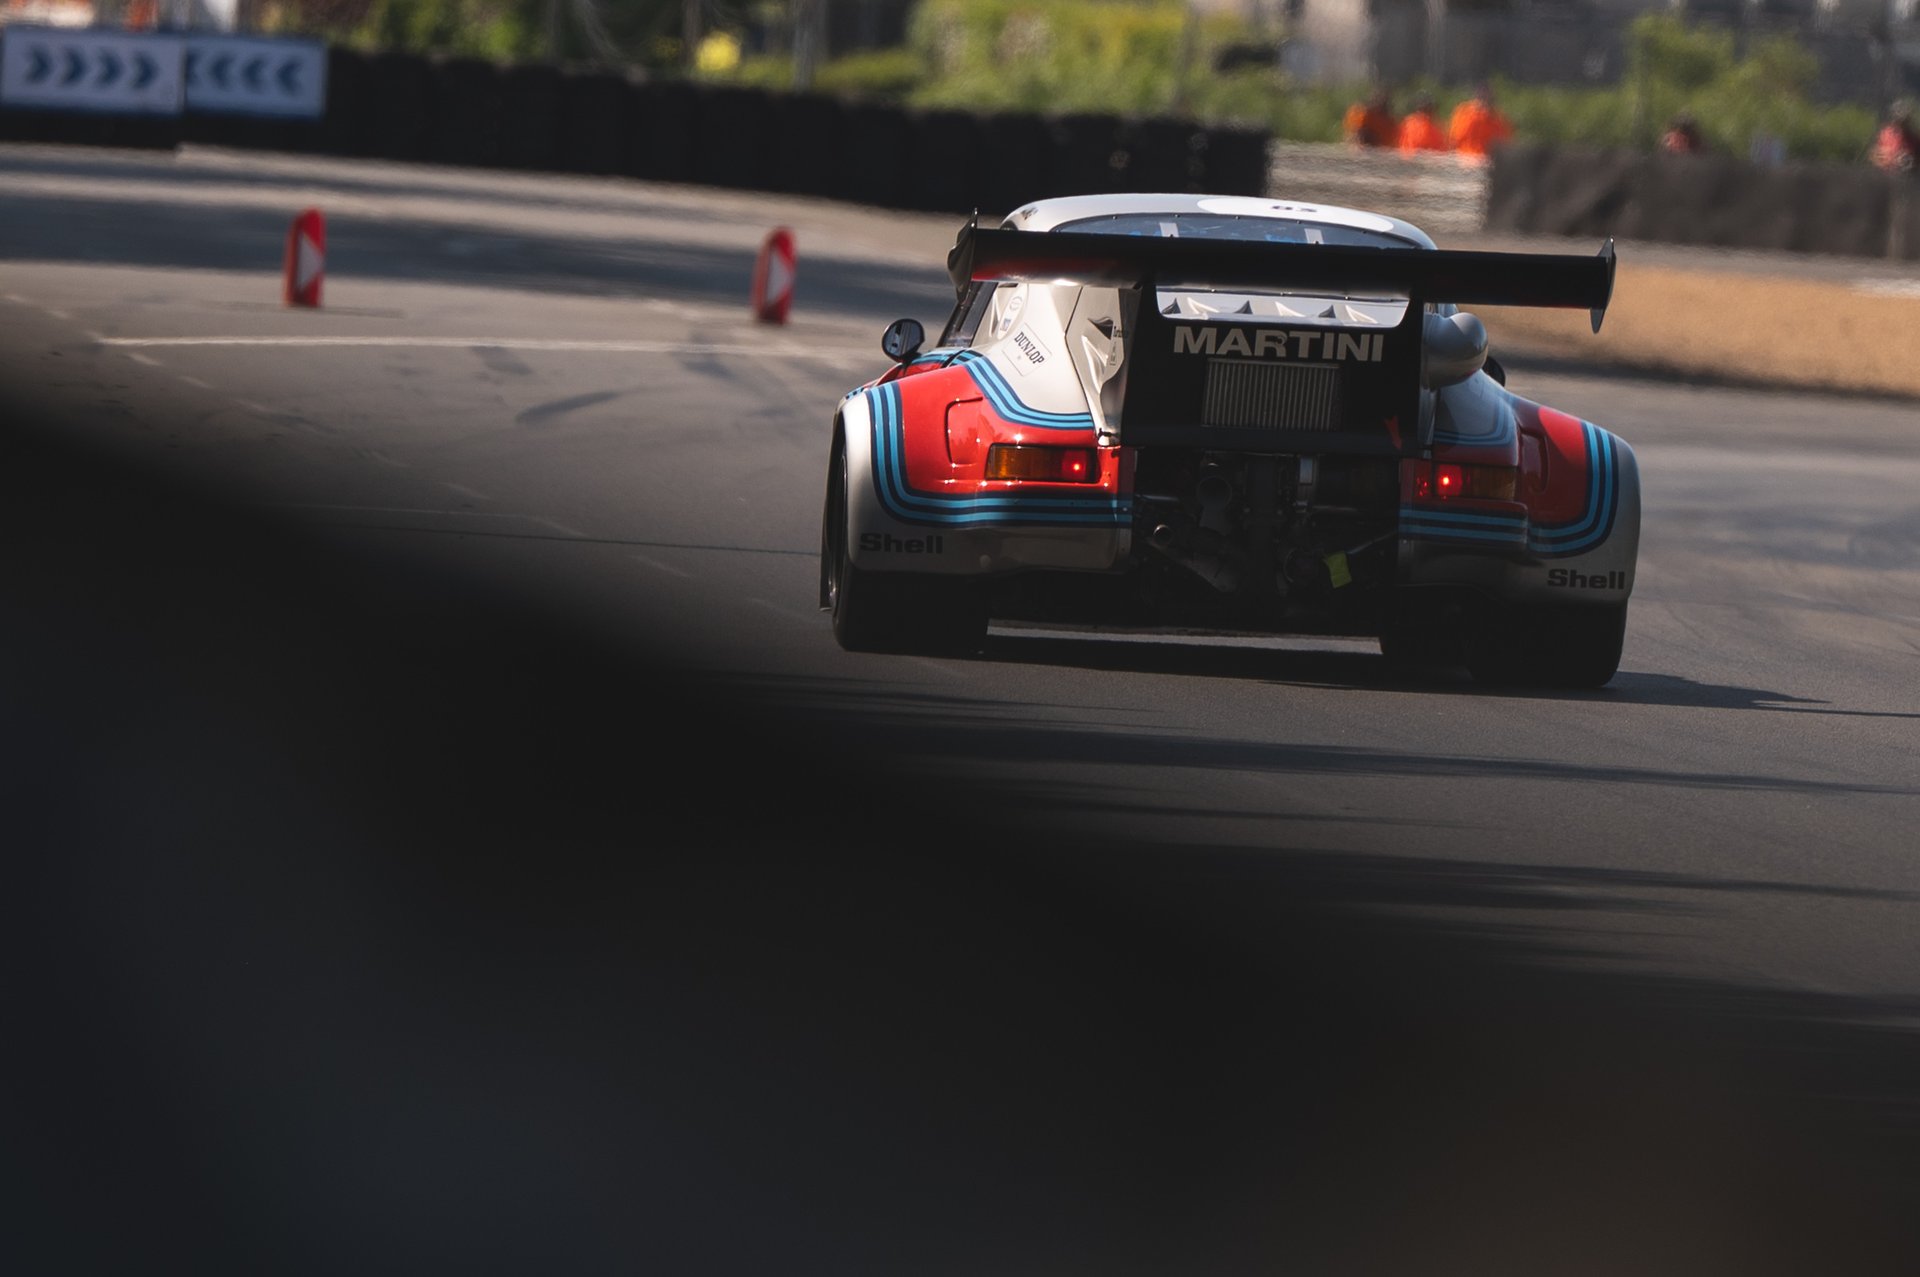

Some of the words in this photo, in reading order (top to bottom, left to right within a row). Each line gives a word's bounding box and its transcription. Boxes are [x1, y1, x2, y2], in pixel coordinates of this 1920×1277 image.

[1014, 331, 1046, 364] DUNLOP
[1173, 326, 1384, 362] MARTINI
[860, 532, 943, 554] Shell
[1547, 568, 1625, 590] Shell
